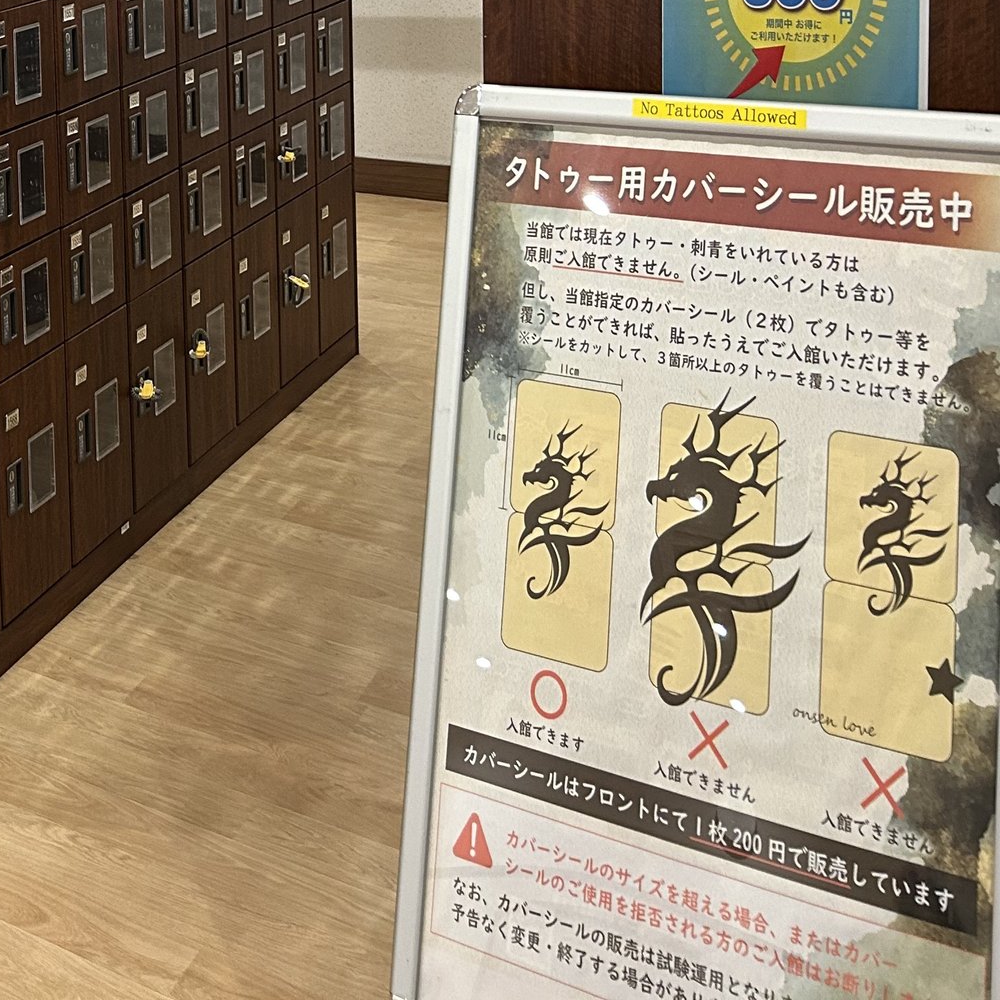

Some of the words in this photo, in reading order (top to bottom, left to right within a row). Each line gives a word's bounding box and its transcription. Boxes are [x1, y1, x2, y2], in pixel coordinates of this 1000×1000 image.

[640, 101, 659, 115] No
[665, 103, 724, 121] Tattoos
[731, 106, 798, 127] Allowed
[504, 154, 974, 234] タトゥー用カバーシール販売中
[525, 220, 860, 274] 当館では現在タトゥー・刺青をいれている方は
[519, 308, 940, 383] 覆うことができれば、貼ったうえでご入館いただけます。
[506, 719, 585, 754] 入館できます
[792, 705, 838, 732] onsen
[842, 719, 878, 738] love
[653, 760, 756, 805] 入館できません
[820, 808, 935, 856] 入館できません
